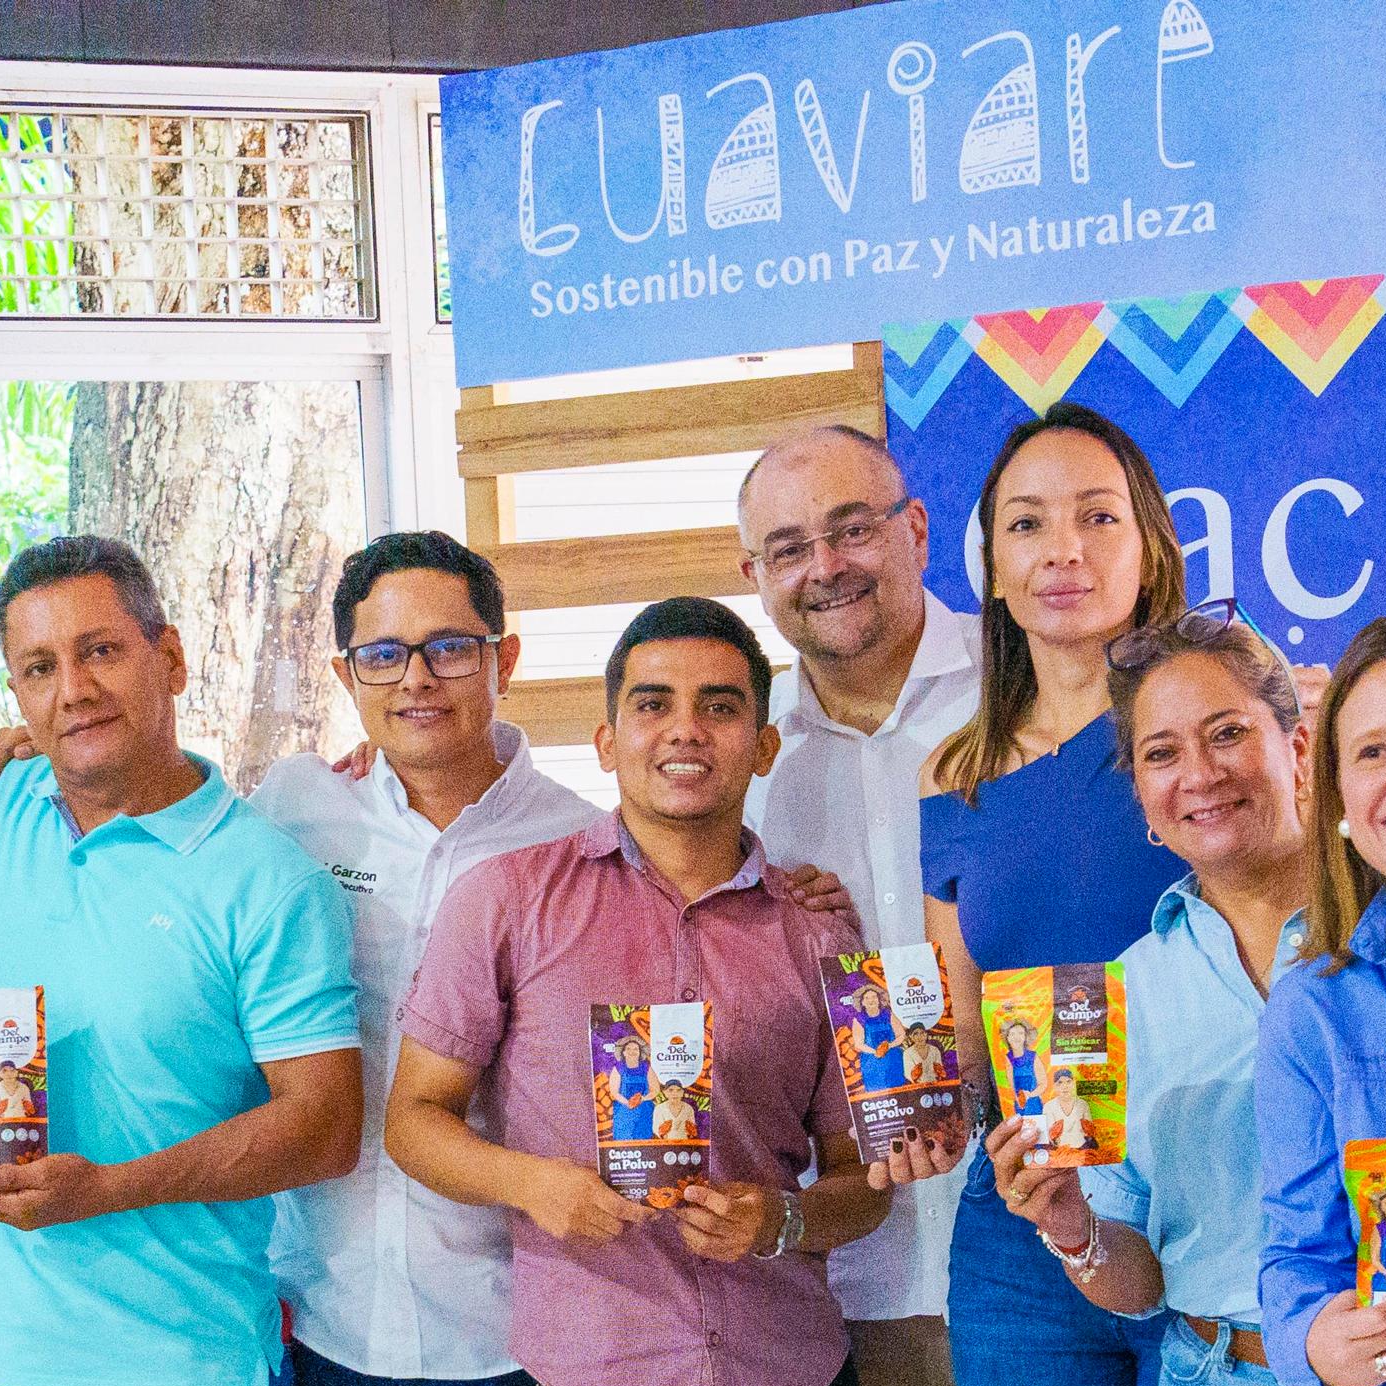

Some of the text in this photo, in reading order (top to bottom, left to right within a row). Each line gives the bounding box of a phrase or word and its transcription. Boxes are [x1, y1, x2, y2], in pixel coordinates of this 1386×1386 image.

[530, 199, 1217, 319] Sostenible con Paz y Naturaleza
[331, 864, 377, 882] Garzon
[905, 985, 926, 997] Del
[896, 993, 938, 1006] Campo
[1069, 998, 1091, 1012] Del
[1058, 1009, 1102, 1022] Campo
[0, 1027, 20, 1038] Del
[667, 1044, 688, 1054] Del
[656, 1052, 698, 1063] Campo
[861, 1098, 898, 1112] Cacao
[864, 1106, 914, 1123] en Polvo
[609, 1149, 642, 1160] Cacao
[609, 1158, 657, 1170] en Polvo
